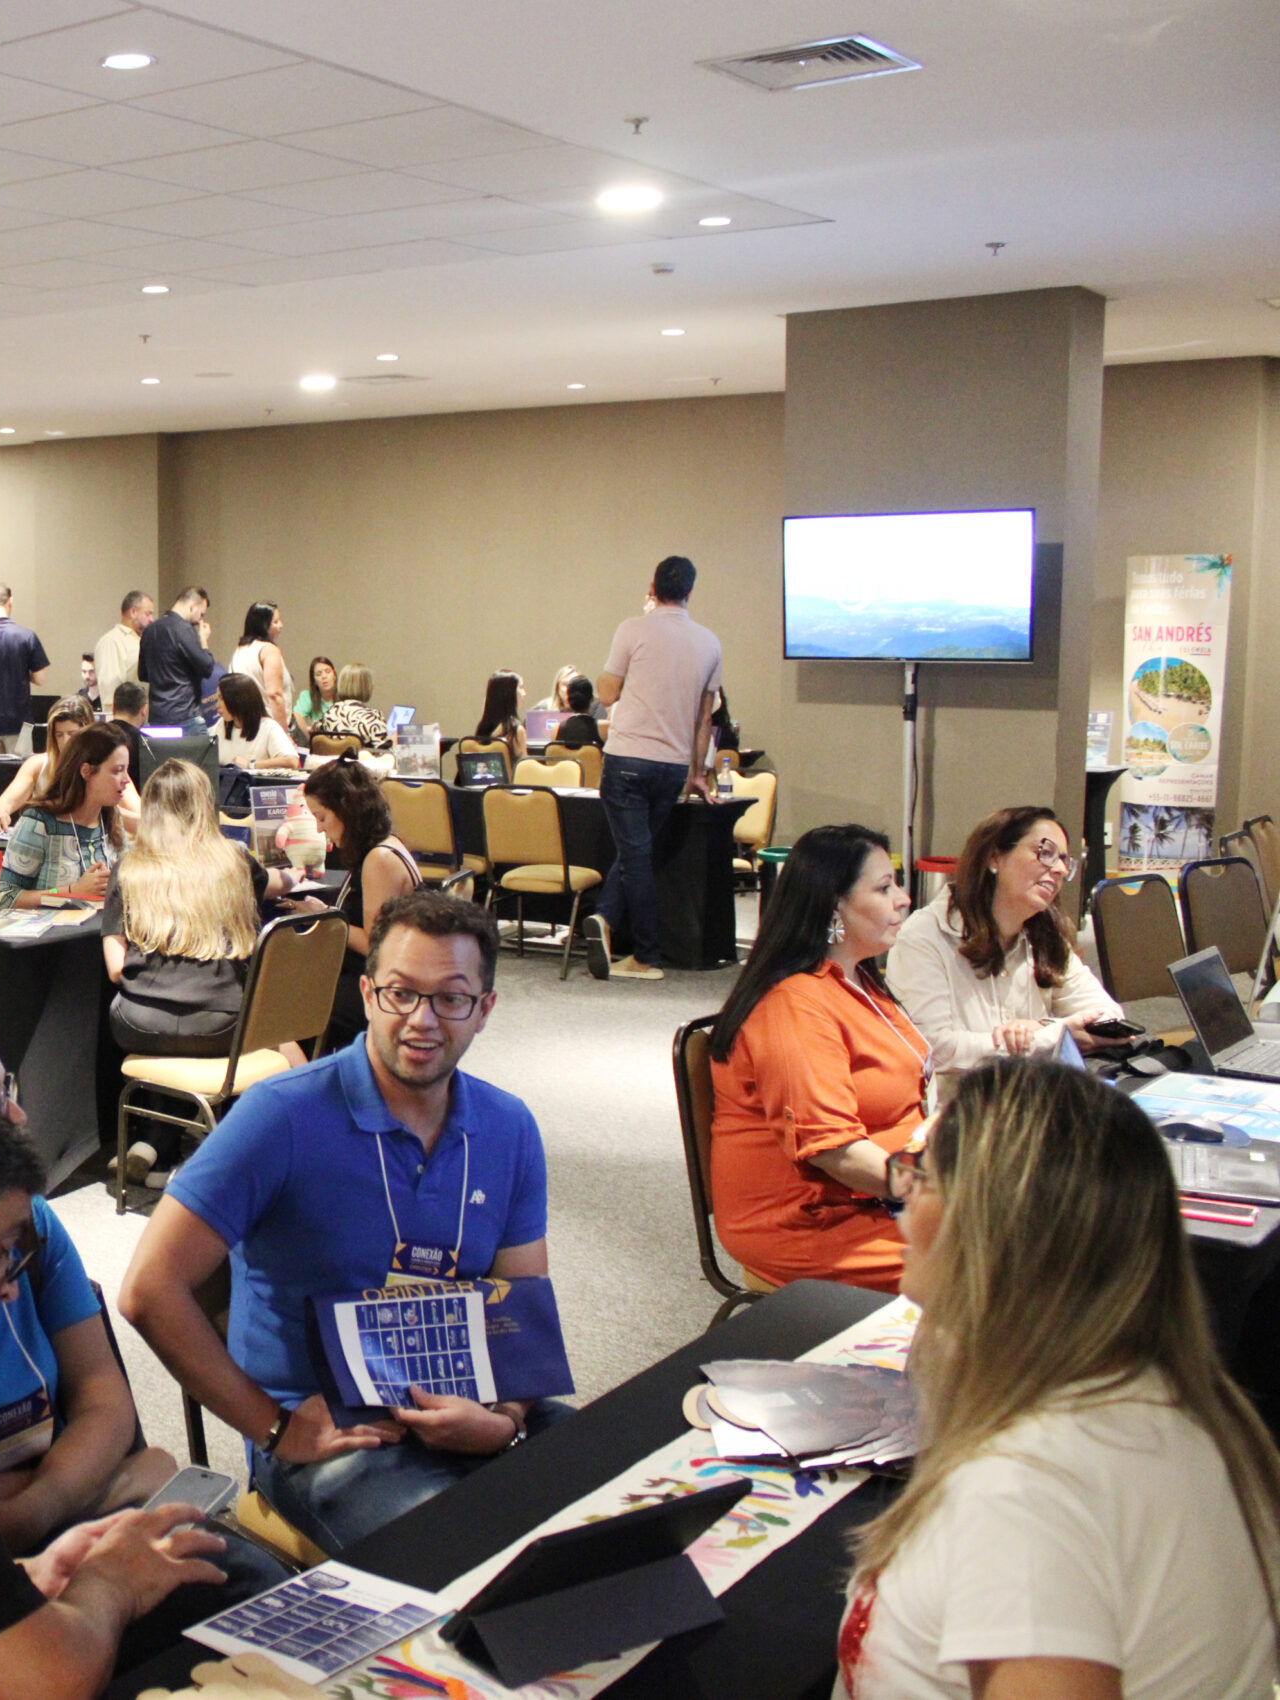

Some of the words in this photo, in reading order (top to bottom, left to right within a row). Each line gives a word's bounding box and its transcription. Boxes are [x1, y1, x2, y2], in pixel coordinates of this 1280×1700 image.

[1132, 625, 1152, 642] SAN
[1155, 621, 1212, 643] ANDRÉS
[411, 1246, 443, 1262] CONEXÃO
[362, 1281, 475, 1302] ORINTER
